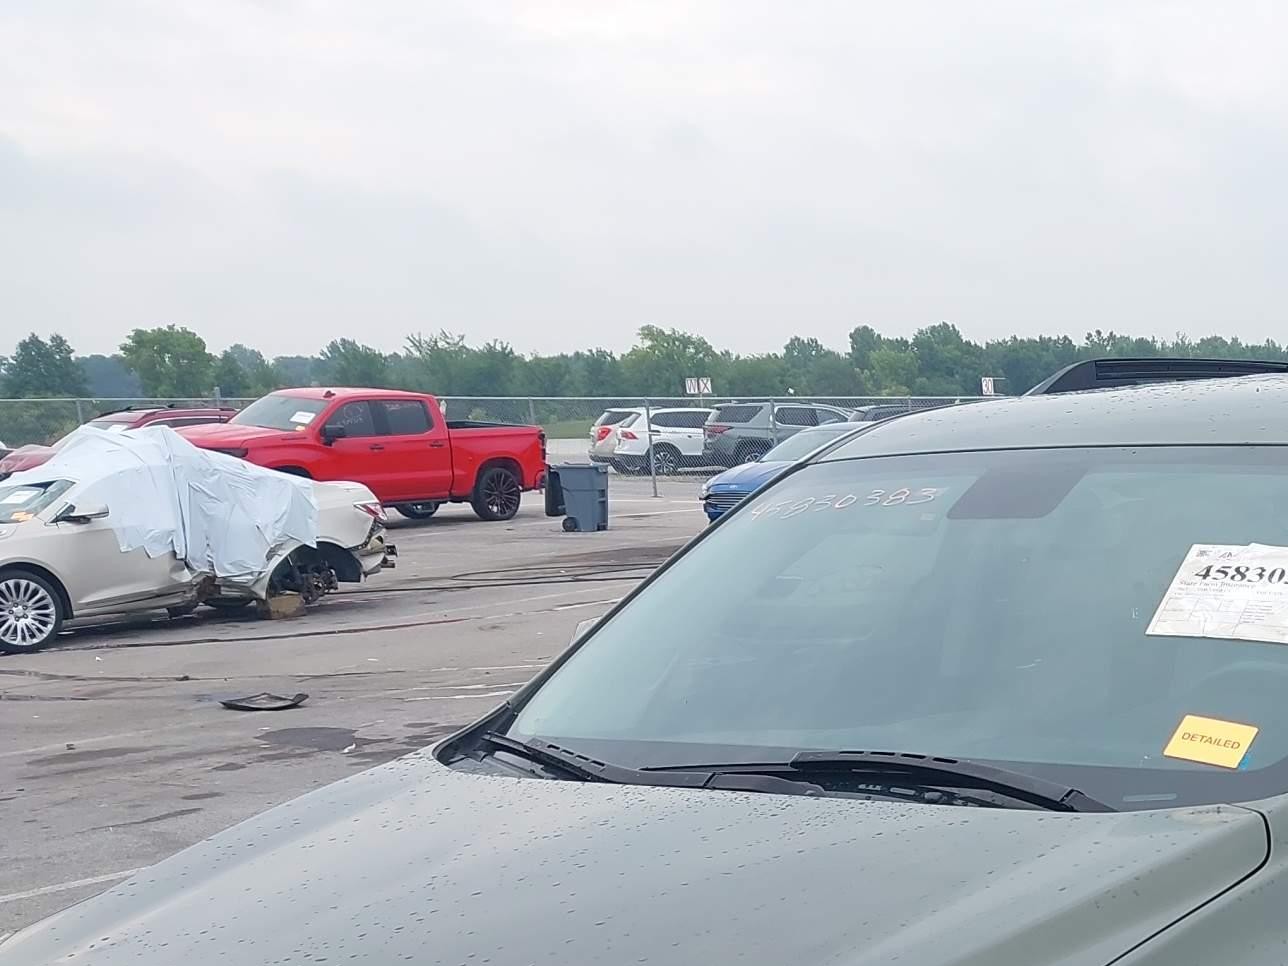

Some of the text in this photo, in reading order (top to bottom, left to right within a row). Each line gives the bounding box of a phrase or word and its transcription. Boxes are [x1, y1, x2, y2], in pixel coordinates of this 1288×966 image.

[687, 379, 711, 393] W X
[1181, 731, 1241, 750] DETAILED
